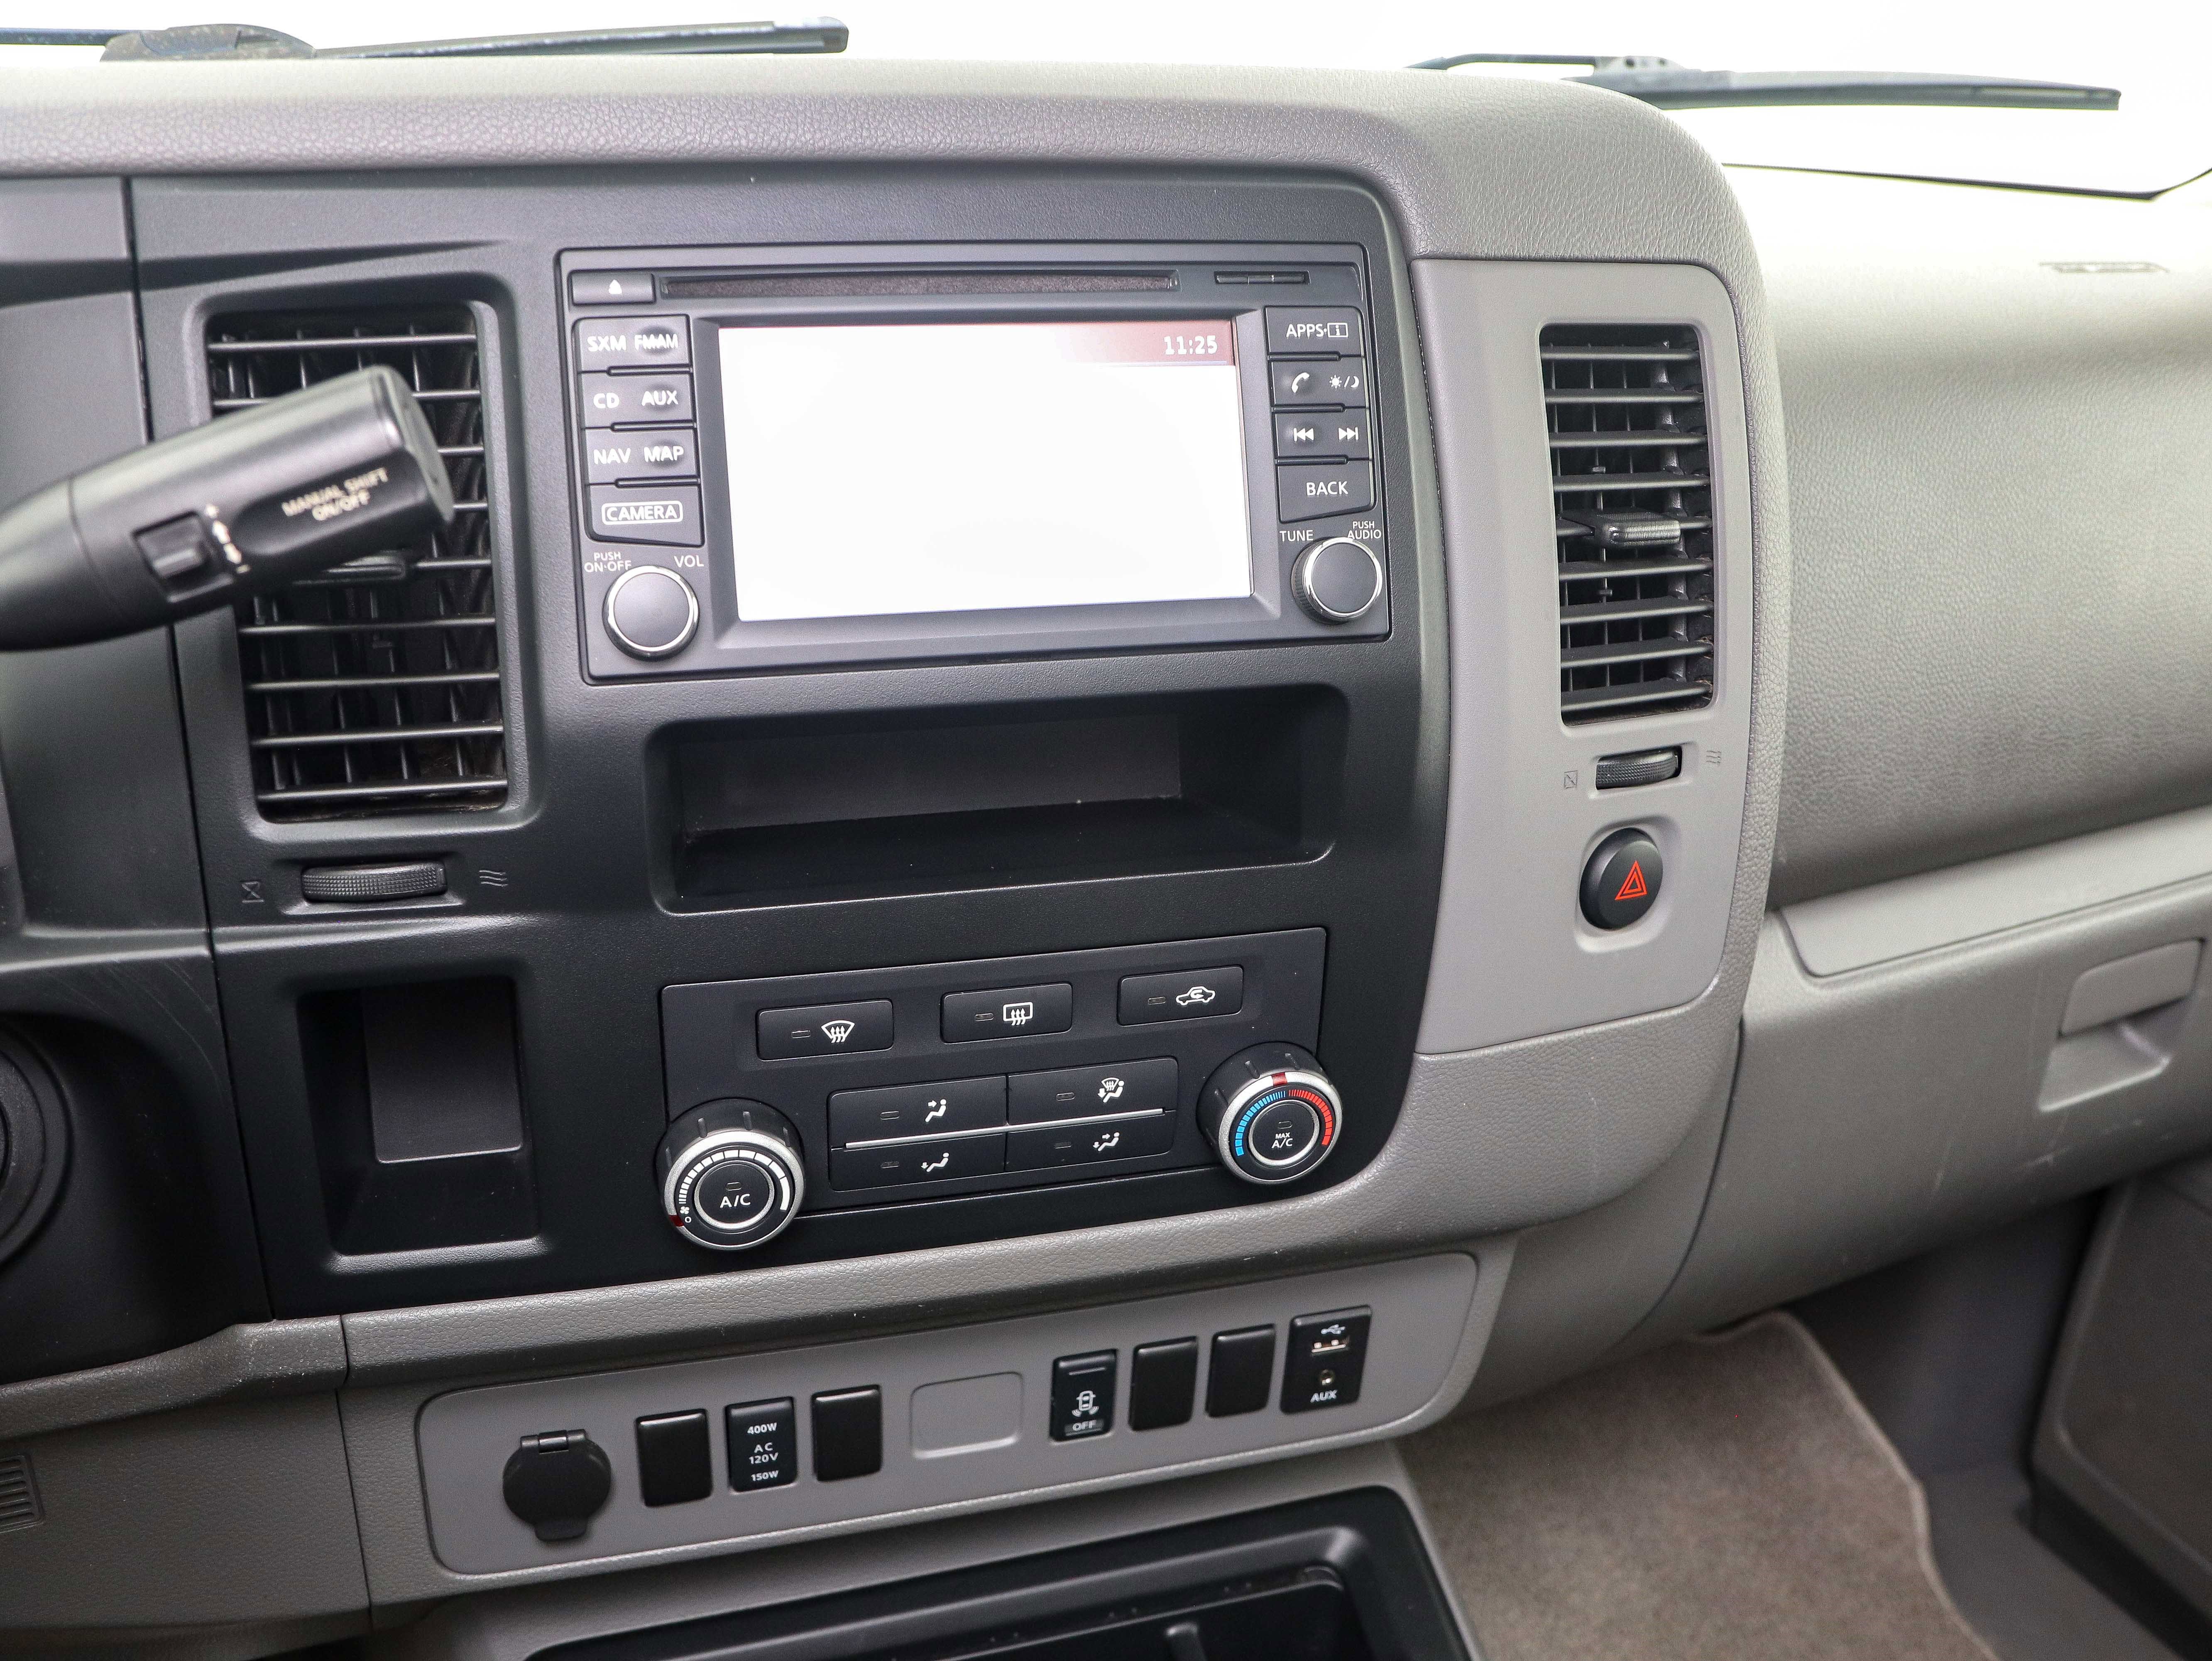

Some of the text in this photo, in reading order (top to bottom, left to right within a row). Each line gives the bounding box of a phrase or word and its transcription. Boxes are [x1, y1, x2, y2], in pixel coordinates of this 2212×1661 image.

[587, 335, 626, 352] SXM
[1163, 335, 1218, 355] 11:25
[593, 390, 679, 408] CD AUX
[593, 445, 684, 465] NAV MAP
[282, 467, 389, 517] MANUAL SHIFT
[1306, 481, 1349, 496] BACK
[606, 505, 678, 522] CAMERA
[1279, 530, 1314, 542] TUNE
[1347, 529, 1382, 539] AUDIO
[593, 551, 622, 561] PUSH
[673, 555, 705, 568] VOL
[1271, 1138, 1293, 1149] A/C
[719, 1193, 751, 1209] A/C
[1310, 1389, 1338, 1403] AUX
[747, 1422, 778, 1435] 400W
[1072, 1419, 1096, 1431] OFF
[749, 1452, 779, 1465] 120V
[751, 1470, 779, 1482] 150W
